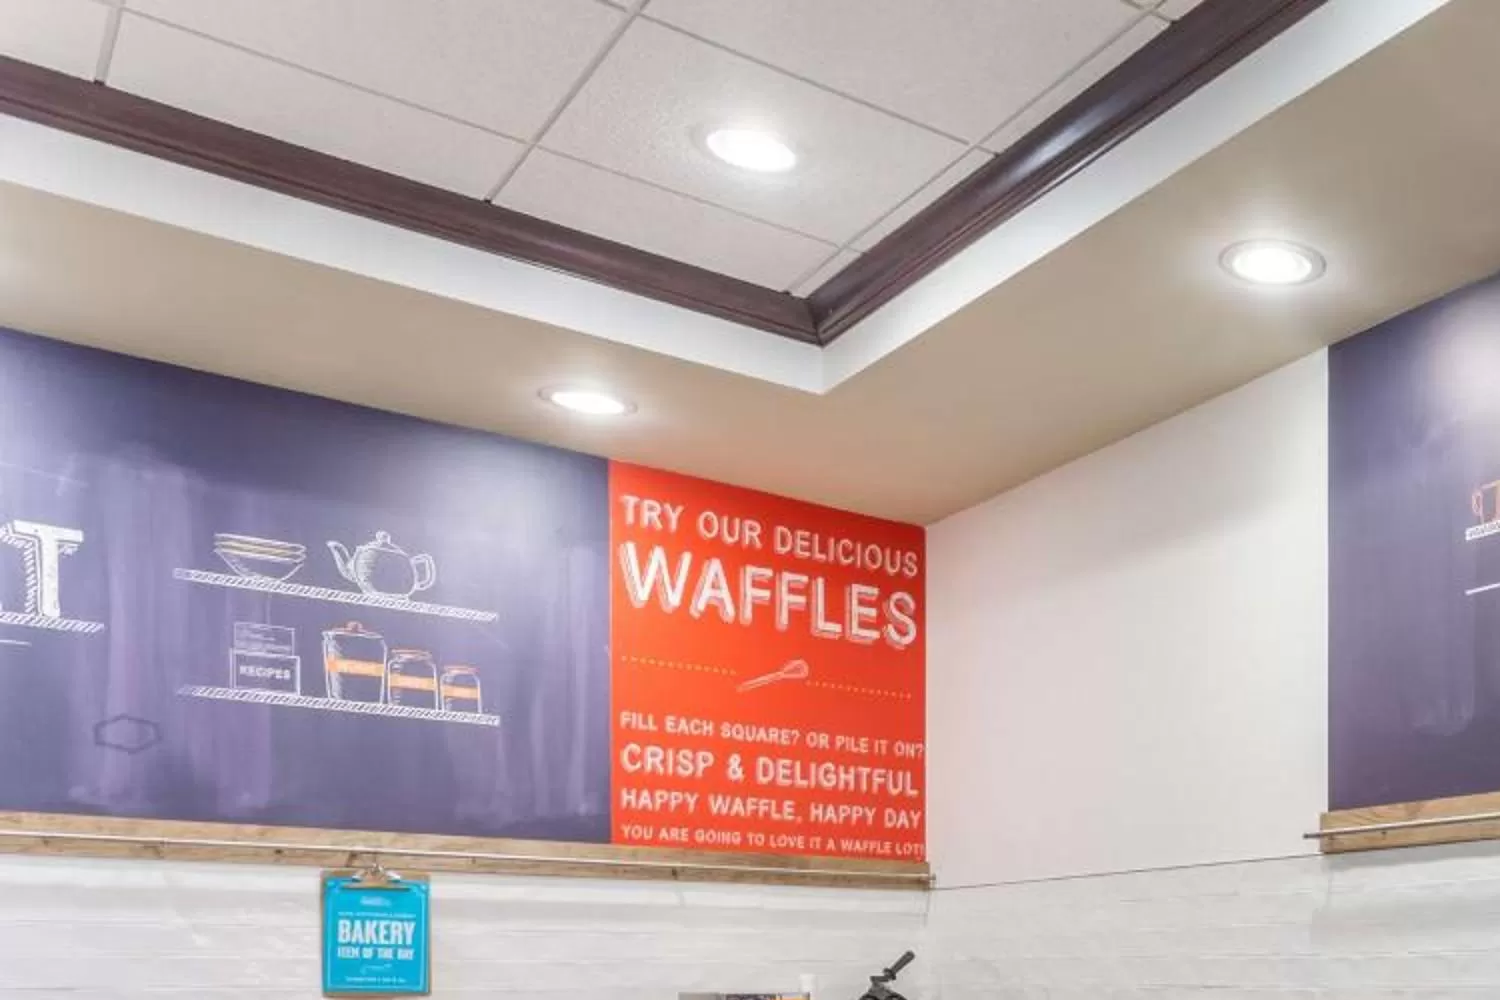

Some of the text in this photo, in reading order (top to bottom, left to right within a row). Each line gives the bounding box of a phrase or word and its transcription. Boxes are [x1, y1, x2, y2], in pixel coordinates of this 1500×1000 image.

[621, 494, 918, 577] TRY OUR DELICIOUS
[619, 540, 917, 649] WAFFLES
[620, 711, 657, 732] FILL
[665, 715, 714, 736] EACH
[720, 721, 800, 747] SQUARE?
[806, 732, 829, 749] OR
[835, 735, 869, 753] PILE
[874, 739, 888, 755] IT
[621, 743, 919, 798] CRISP & DELIGHTFUL
[621, 787, 699, 814] HAPPY
[809, 802, 877, 826] HAPPY
[884, 807, 922, 829] DAY
[621, 823, 653, 840] YOU
[659, 827, 689, 842] ARE
[695, 829, 741, 845] GOING
[747, 832, 764, 846] TO
[769, 834, 805, 849] LOVE
[809, 836, 822, 849] IT
[825, 838, 836, 851] A
[839, 838, 892, 855] WAFFLE
[338, 919, 416, 945] BAKERY
